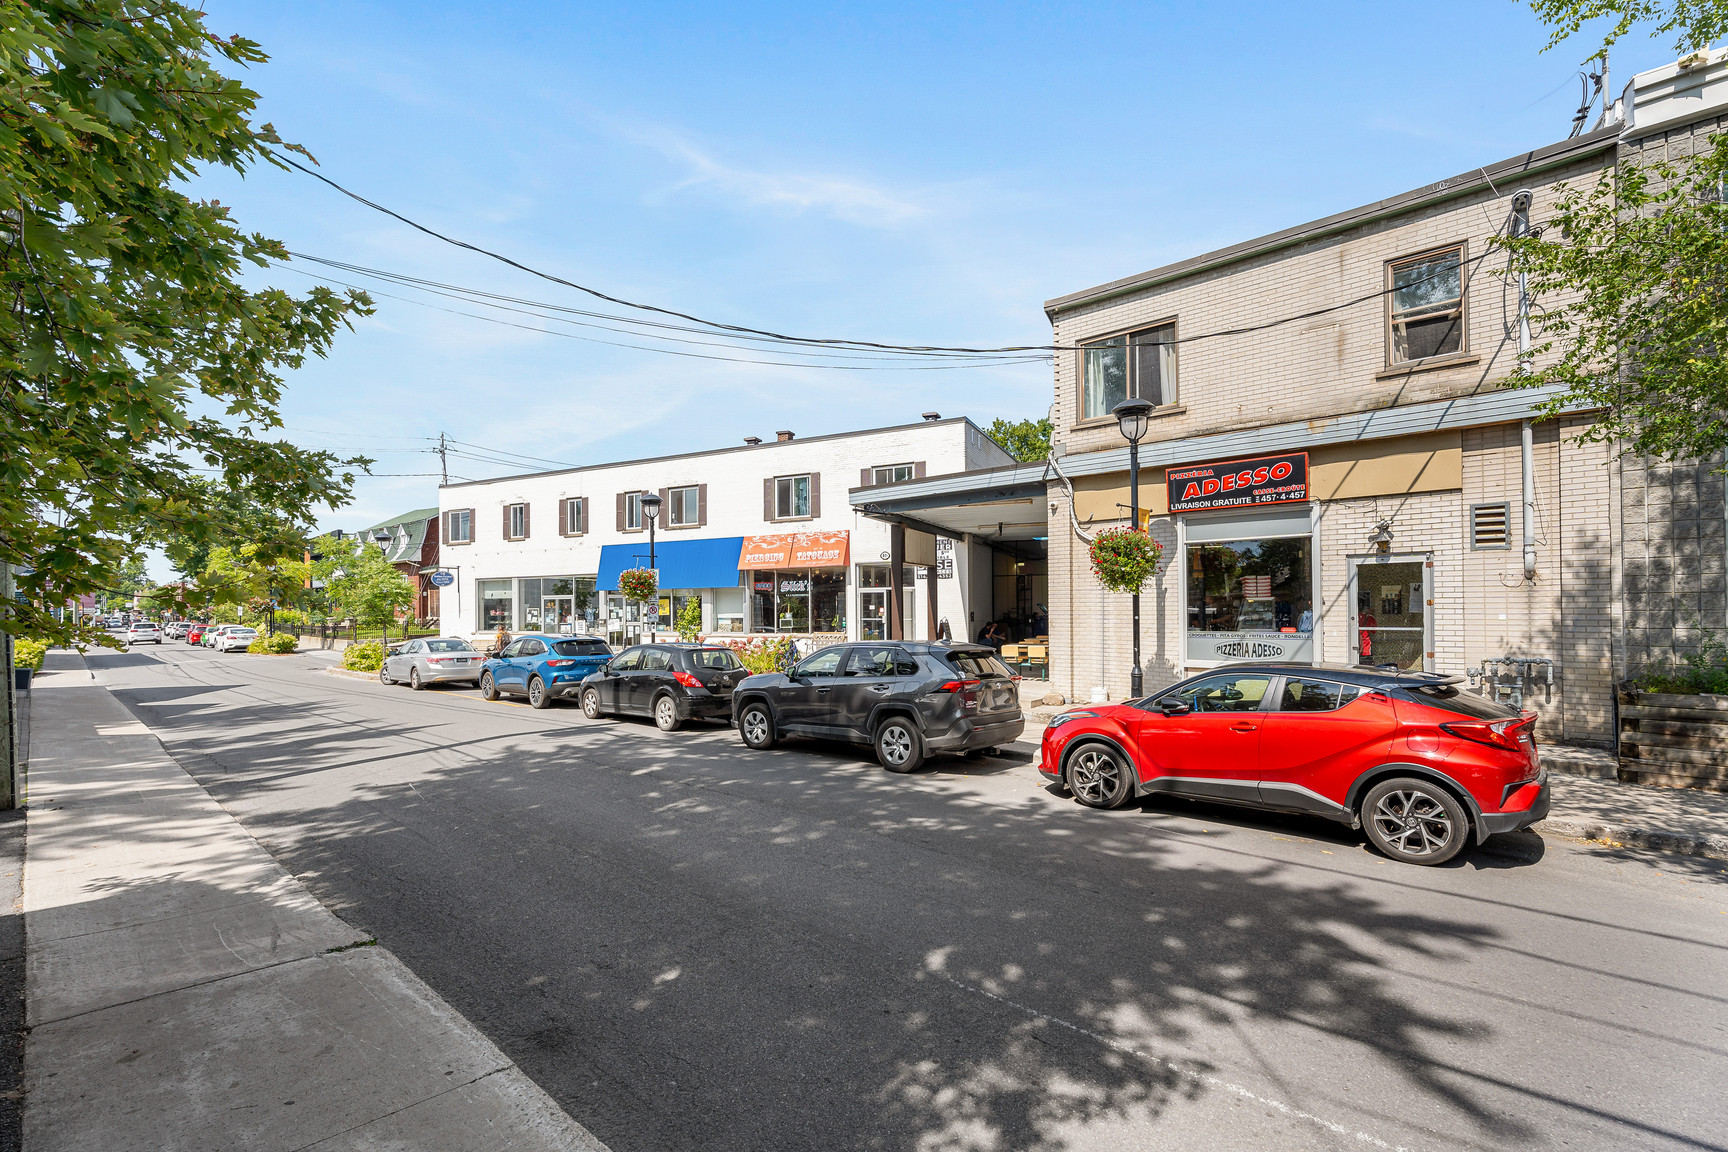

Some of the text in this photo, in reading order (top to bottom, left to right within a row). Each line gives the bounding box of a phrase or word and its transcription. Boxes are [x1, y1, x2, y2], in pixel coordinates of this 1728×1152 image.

[1170, 469, 1214, 480] PIZZÉRIA
[1182, 462, 1293, 500] ADESSO
[1252, 484, 1306, 496] CASSE-CROÛTE
[1171, 496, 1252, 511] LIVRAISON GRATUITE
[796, 549, 840, 561] TATOUAGE
[1216, 641, 1283, 658] PIZZÉRIA ADESSO
